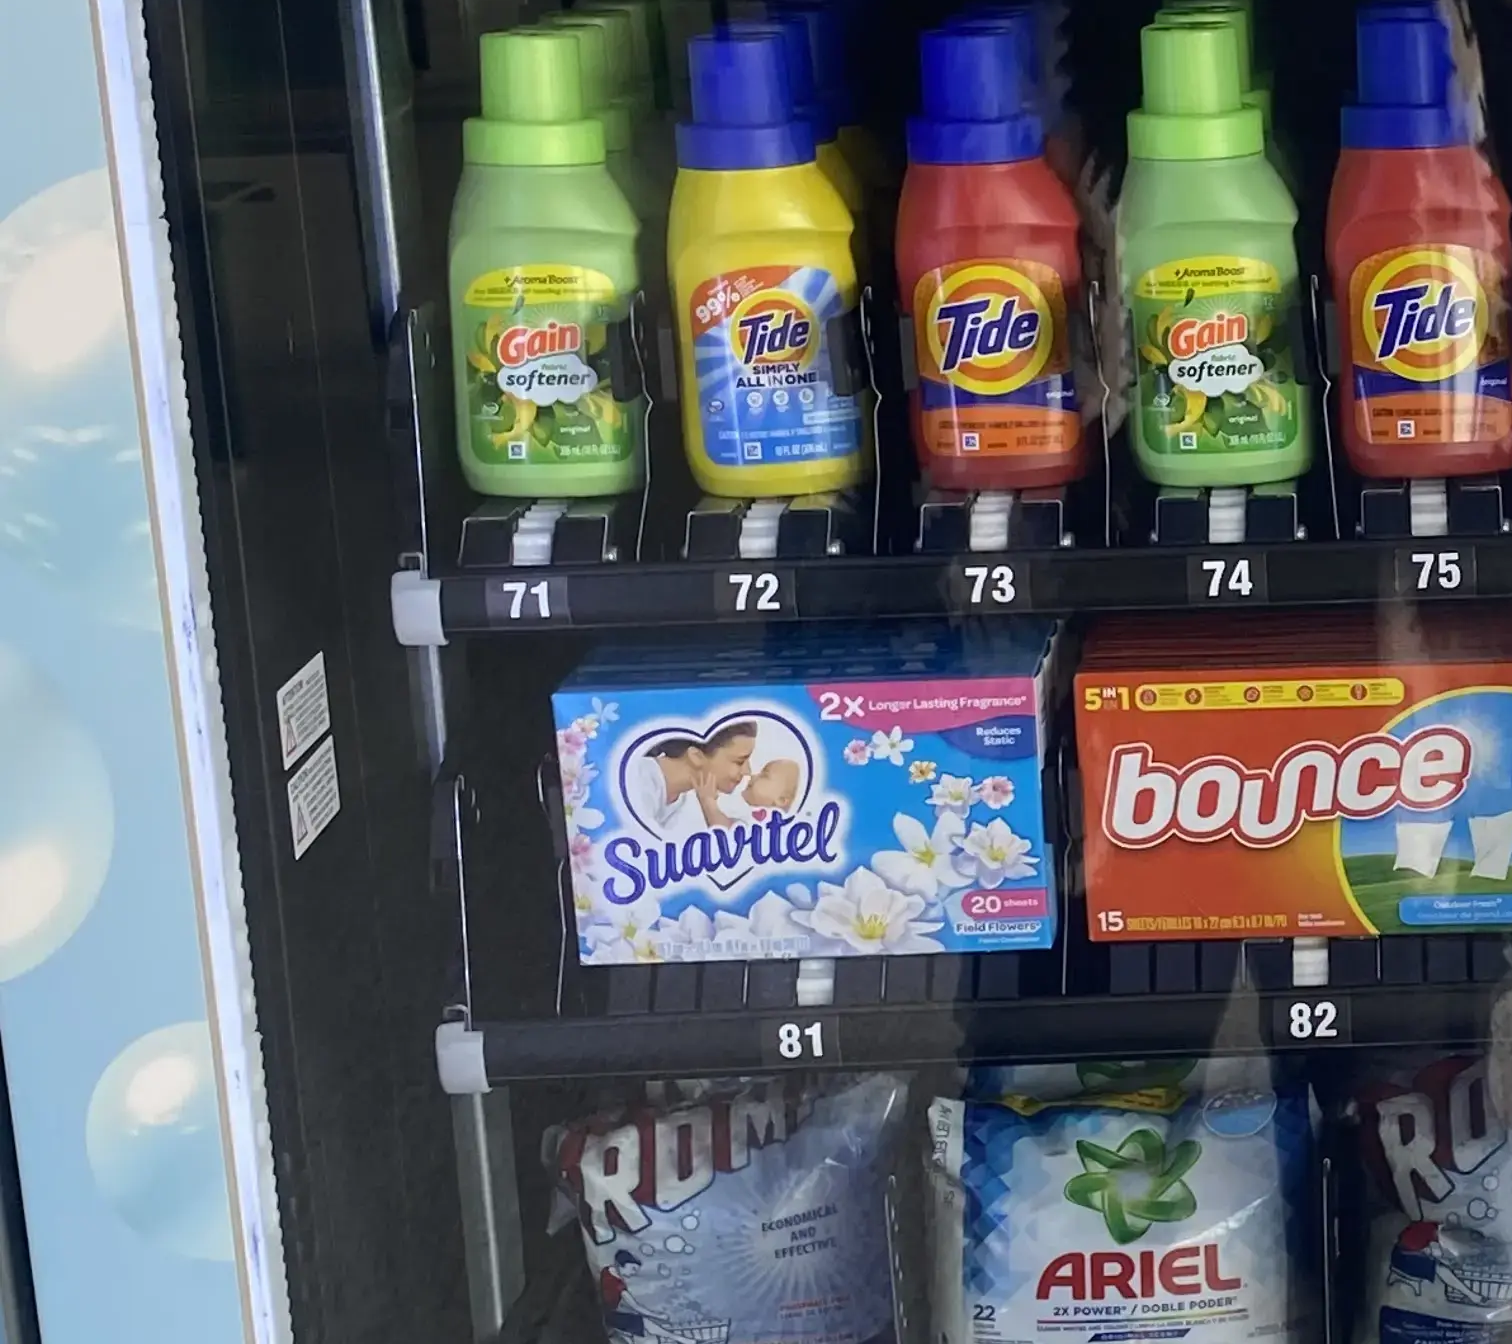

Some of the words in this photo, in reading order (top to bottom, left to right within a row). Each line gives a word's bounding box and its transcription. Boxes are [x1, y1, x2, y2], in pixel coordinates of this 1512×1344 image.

[695, 285, 741, 324] 99%
[1373, 282, 1477, 363] Tide
[497, 321, 582, 367] Gain
[736, 308, 811, 366] Tide
[936, 296, 1040, 375] Tide
[1167, 311, 1249, 360] Gain
[505, 370, 591, 392] softener
[736, 375, 767, 389] ALL
[768, 374, 785, 387] IN
[785, 371, 818, 386] ONE
[752, 362, 801, 375] SIMPLY
[1176, 359, 1258, 382] softener
[964, 565, 1016, 604] 73
[1202, 559, 1252, 597] 74
[1411, 552, 1462, 590] 75
[503, 580, 551, 620] 71
[729, 573, 781, 611] 72
[868, 699, 912, 712] Longer
[913, 697, 958, 711] Lasting
[1084, 687, 1102, 711] 5
[1117, 686, 1130, 710] 1
[976, 726, 1022, 737] Reduces
[984, 736, 1016, 746] Static
[1102, 724, 1472, 849] bounce
[602, 801, 841, 906] Suavitel
[970, 895, 1002, 914] 20
[1003, 898, 1039, 907] sheets
[1097, 911, 1124, 931] 15
[956, 923, 986, 933] Field
[1289, 1001, 1338, 1038] 82
[777, 1021, 824, 1058] 81
[580, 1096, 805, 1246] ROM
[760, 1204, 839, 1233] ECONOMICAL
[790, 1227, 817, 1242] AND
[774, 1237, 837, 1259] EFFECTIVE
[1036, 1244, 1242, 1301] ARIEL
[973, 1304, 996, 1322] 22
[1053, 1306, 1069, 1316] 2X
[1141, 1301, 1185, 1314] DOBLE
